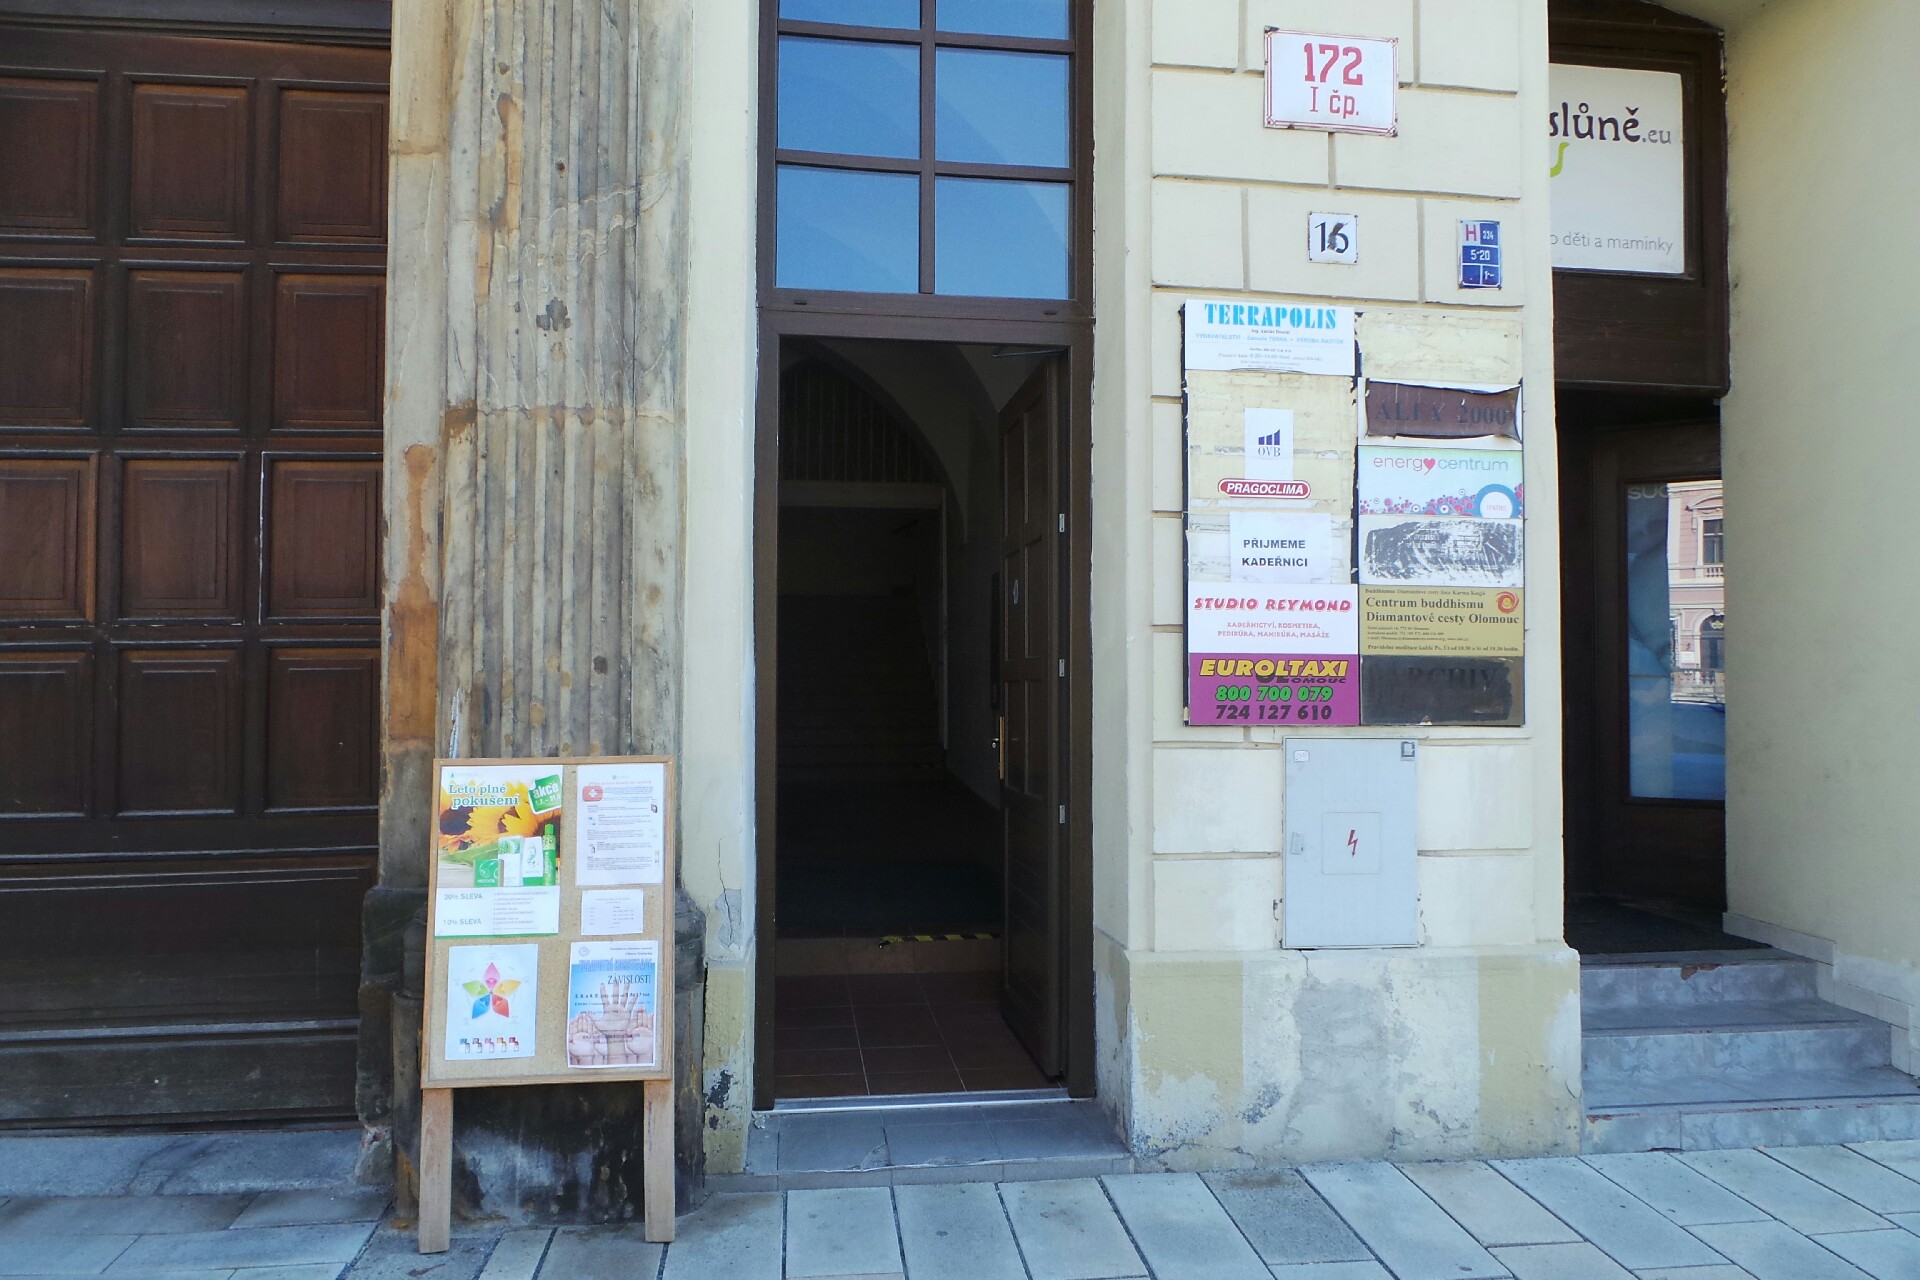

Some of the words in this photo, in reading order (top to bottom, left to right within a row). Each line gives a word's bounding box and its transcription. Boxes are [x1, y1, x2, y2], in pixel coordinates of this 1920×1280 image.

[1303, 43, 1363, 86] 172
[1310, 86, 1319, 112] I
[1329, 89, 1359, 119] čp.
[1314, 222, 1349, 254] 16
[1465, 224, 1477, 241] H
[1562, 231, 1590, 247] děti
[1594, 238, 1602, 248] a
[1607, 236, 1673, 256] maminky
[1204, 303, 1336, 329] TERRAPOLIS
[1458, 404, 1507, 425] 2000
[1258, 447, 1280, 457] OVB
[1438, 458, 1508, 471] centrum
[1226, 483, 1304, 495] PRAGOCLIMA
[1243, 538, 1306, 549] PŘIJMEME
[1242, 556, 1308, 567] KADEŘNICI
[1194, 598, 1259, 611] STUDIO
[1265, 599, 1352, 612] REYMOND
[1366, 596, 1417, 608] Centrum
[1421, 598, 1484, 609] buddhismu
[1366, 611, 1435, 623] Diamantové
[1437, 615, 1465, 625] cesty
[1468, 613, 1519, 624] Olomouc
[1215, 685, 1251, 701] 800
[1257, 686, 1292, 702] 700
[1298, 686, 1333, 702] 079
[1216, 705, 1250, 719] 724
[1258, 705, 1292, 719] 127
[1298, 705, 1332, 720] 610
[480, 784, 506, 795] plné
[453, 793, 519, 808] pokušení
